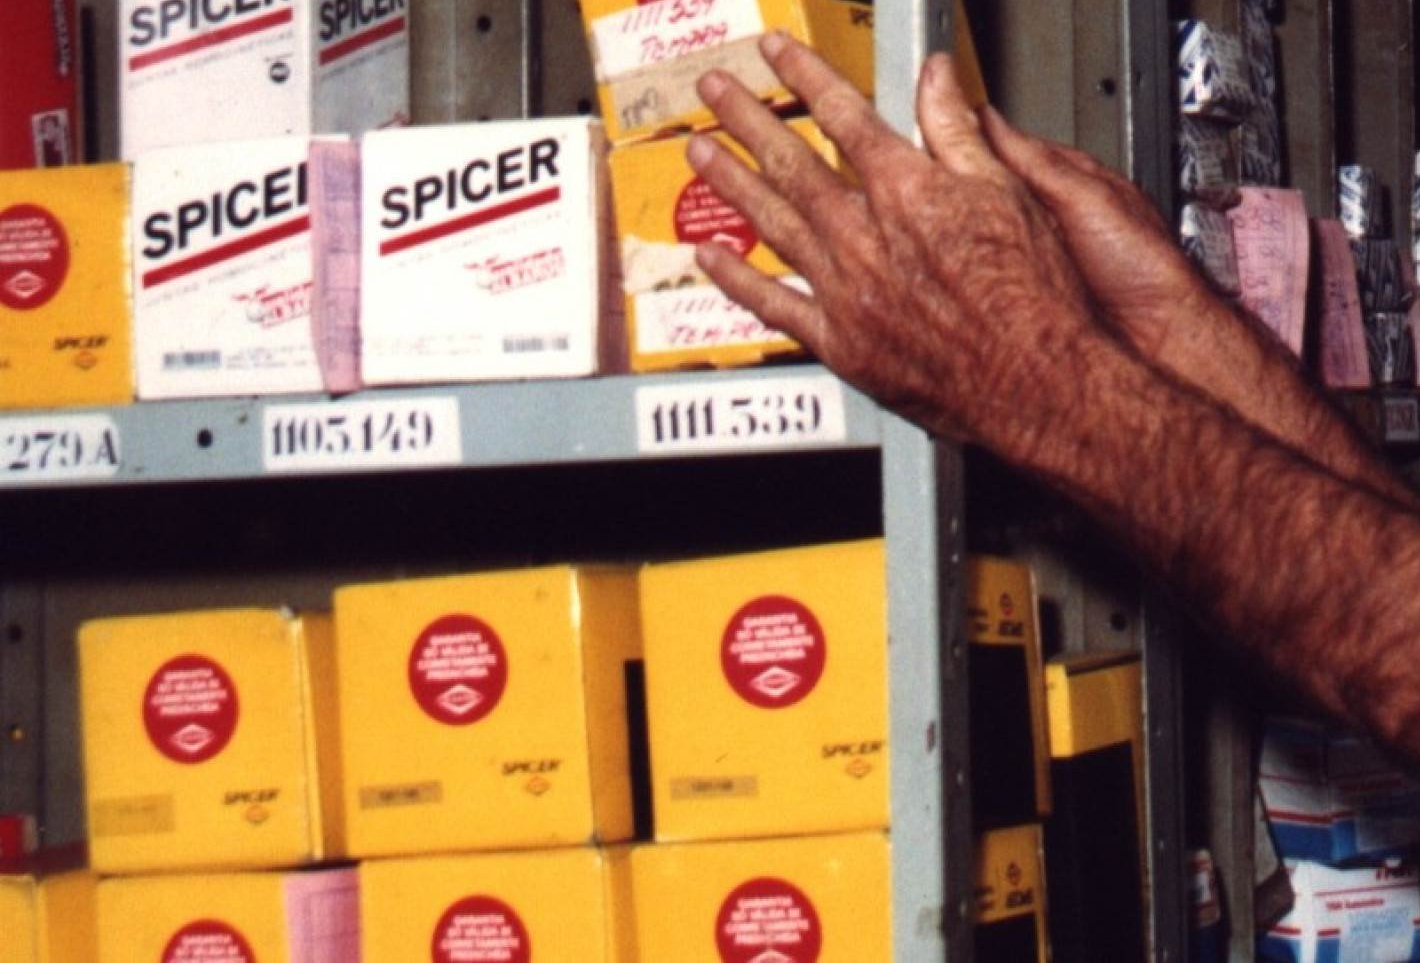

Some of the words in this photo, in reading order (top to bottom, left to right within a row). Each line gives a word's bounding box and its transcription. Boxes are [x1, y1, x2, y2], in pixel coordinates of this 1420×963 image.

[380, 137, 560, 230] SPICER
[822, 741, 882, 759] SPICER
[502, 759, 560, 776] SPICER
[223, 789, 279, 806] SPICER
